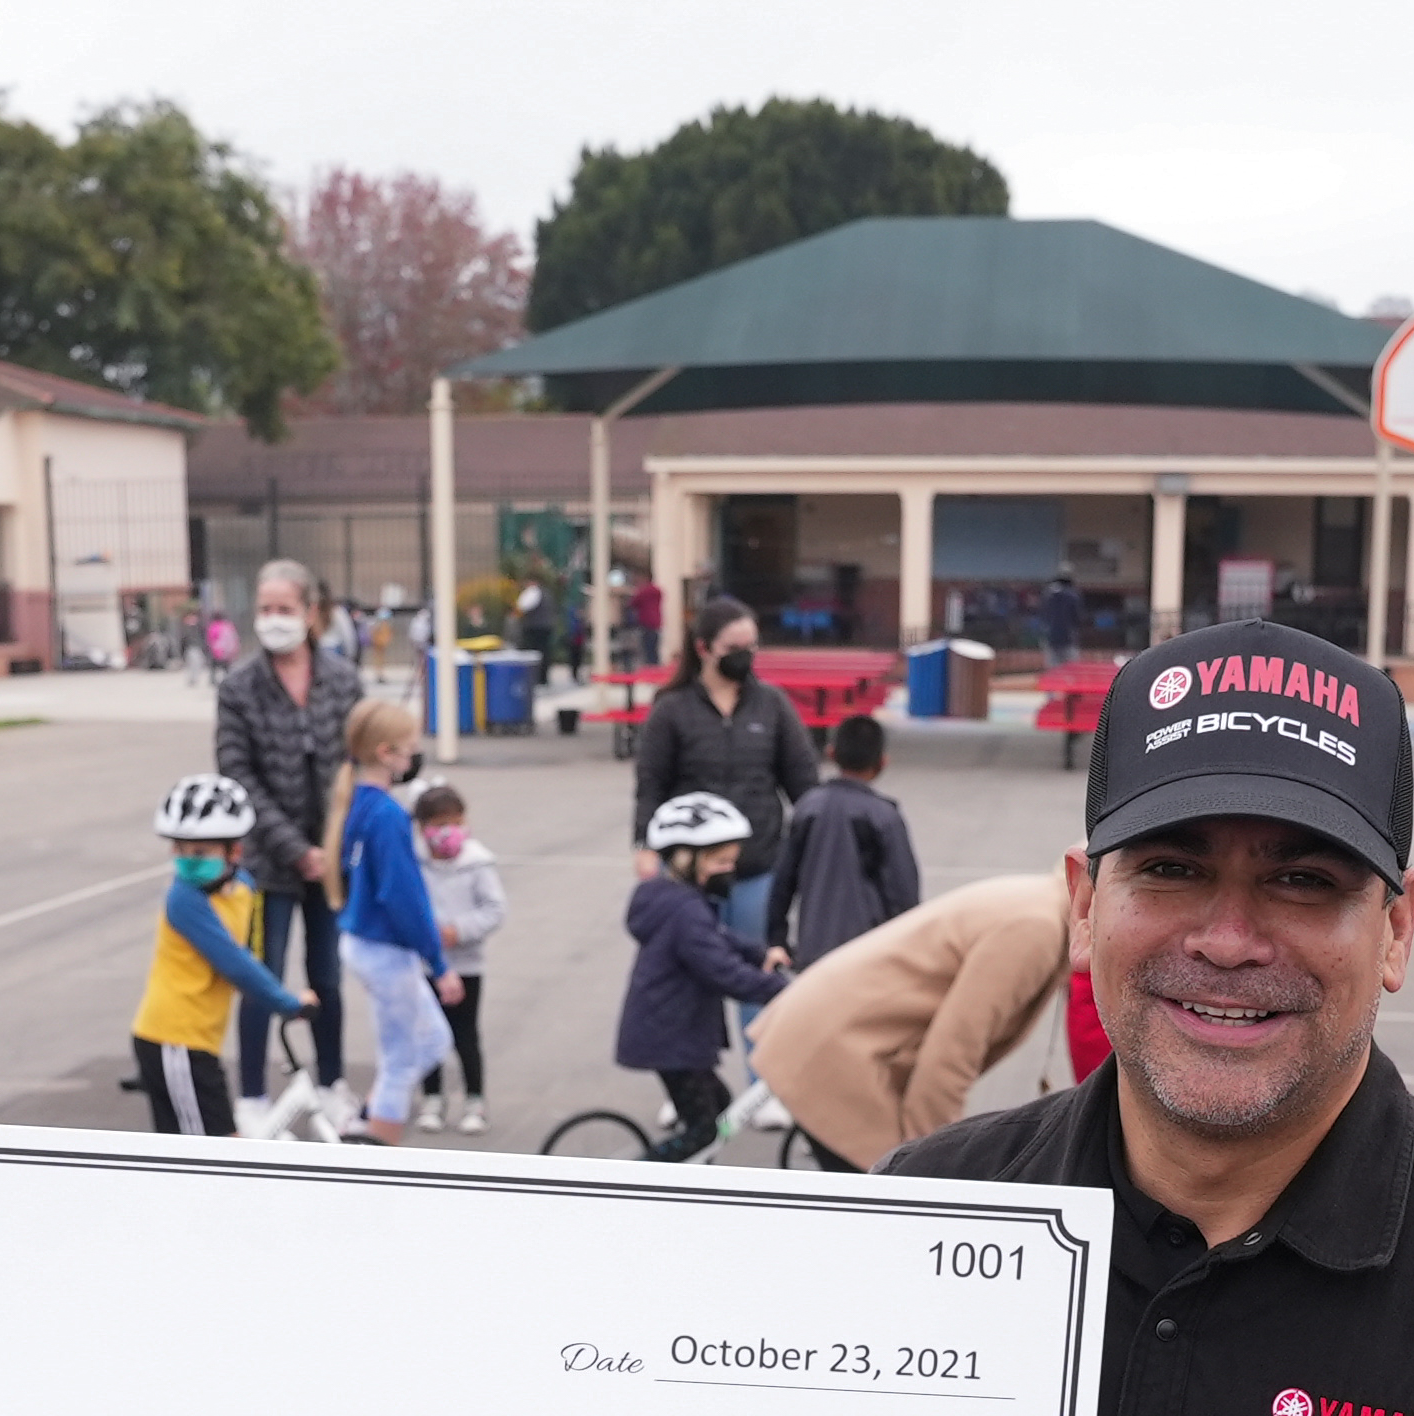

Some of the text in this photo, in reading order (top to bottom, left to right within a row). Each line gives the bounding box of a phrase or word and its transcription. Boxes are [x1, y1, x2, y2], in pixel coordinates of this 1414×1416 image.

[1196, 655, 1360, 727] YAMAHA
[1145, 729, 1191, 754] ASSIST
[1146, 719, 1192, 744] POWER
[1197, 712, 1356, 765] BICYCLES
[929, 1241, 1023, 1280] 1001
[561, 1336, 980, 1380] Date October 23, 2021
